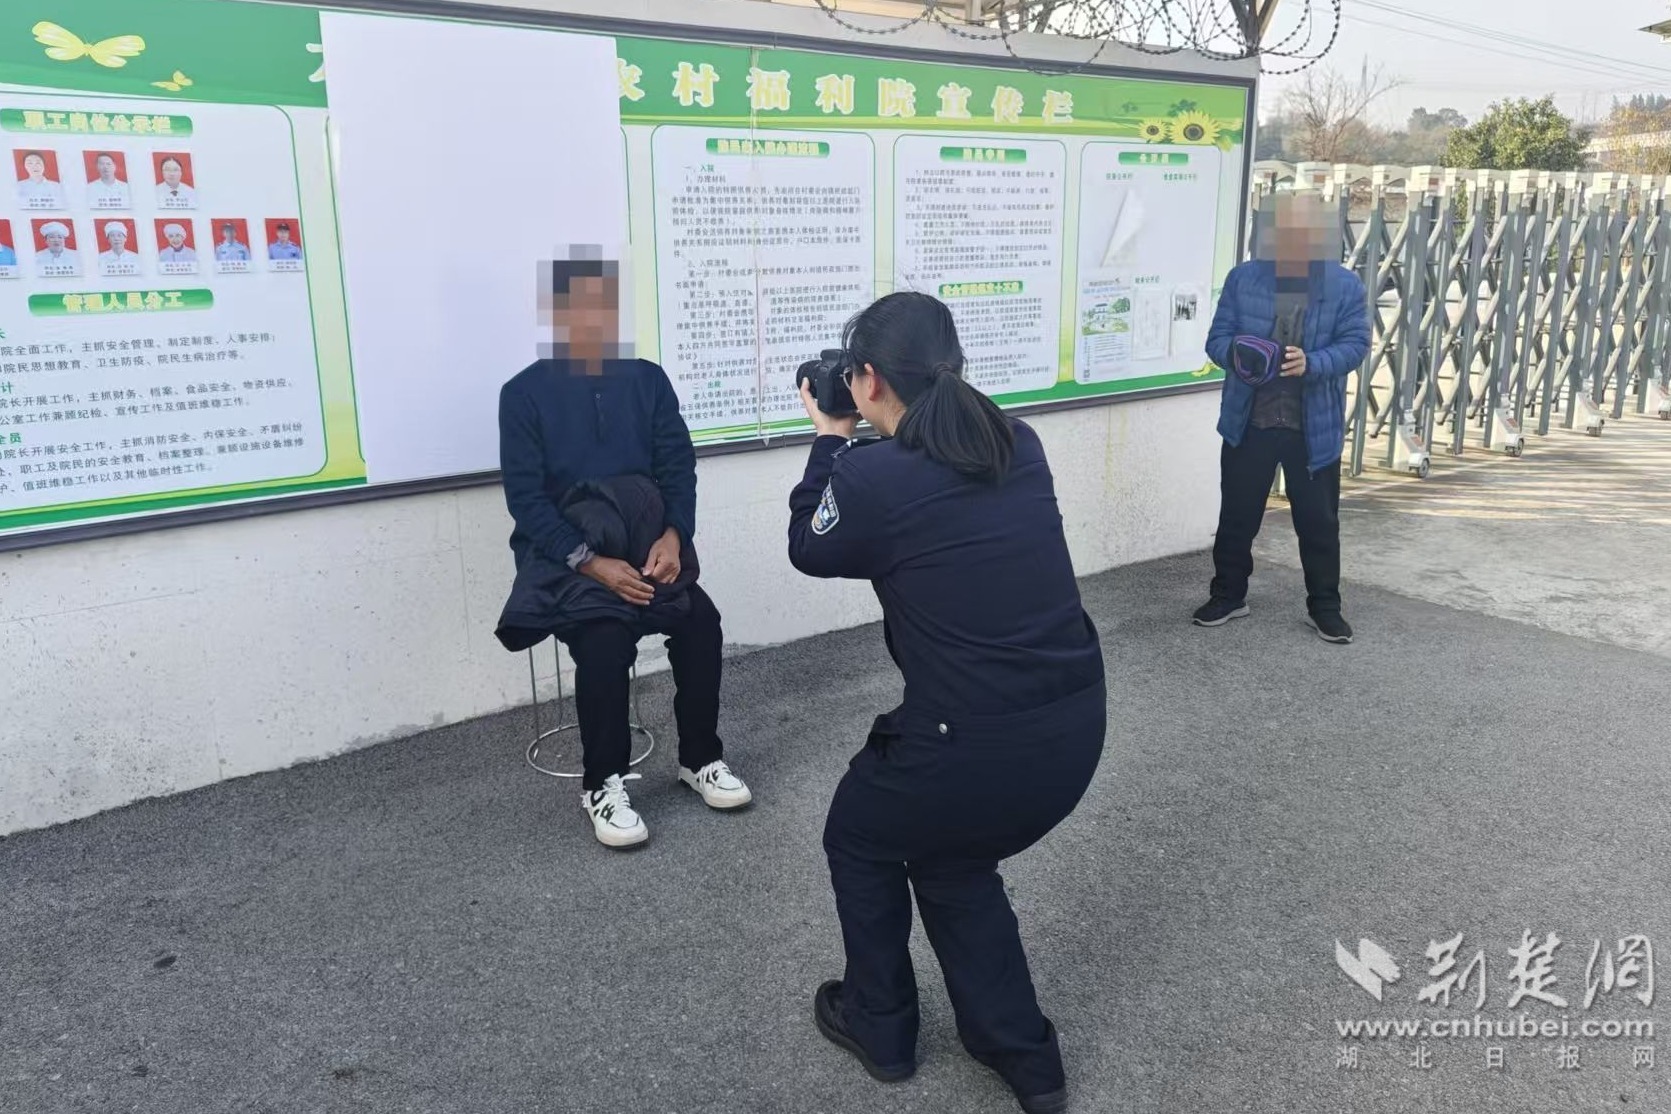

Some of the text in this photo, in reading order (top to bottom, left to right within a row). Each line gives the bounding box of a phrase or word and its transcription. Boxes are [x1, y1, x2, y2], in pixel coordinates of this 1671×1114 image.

[62, 290, 185, 313] 管理人员分工
